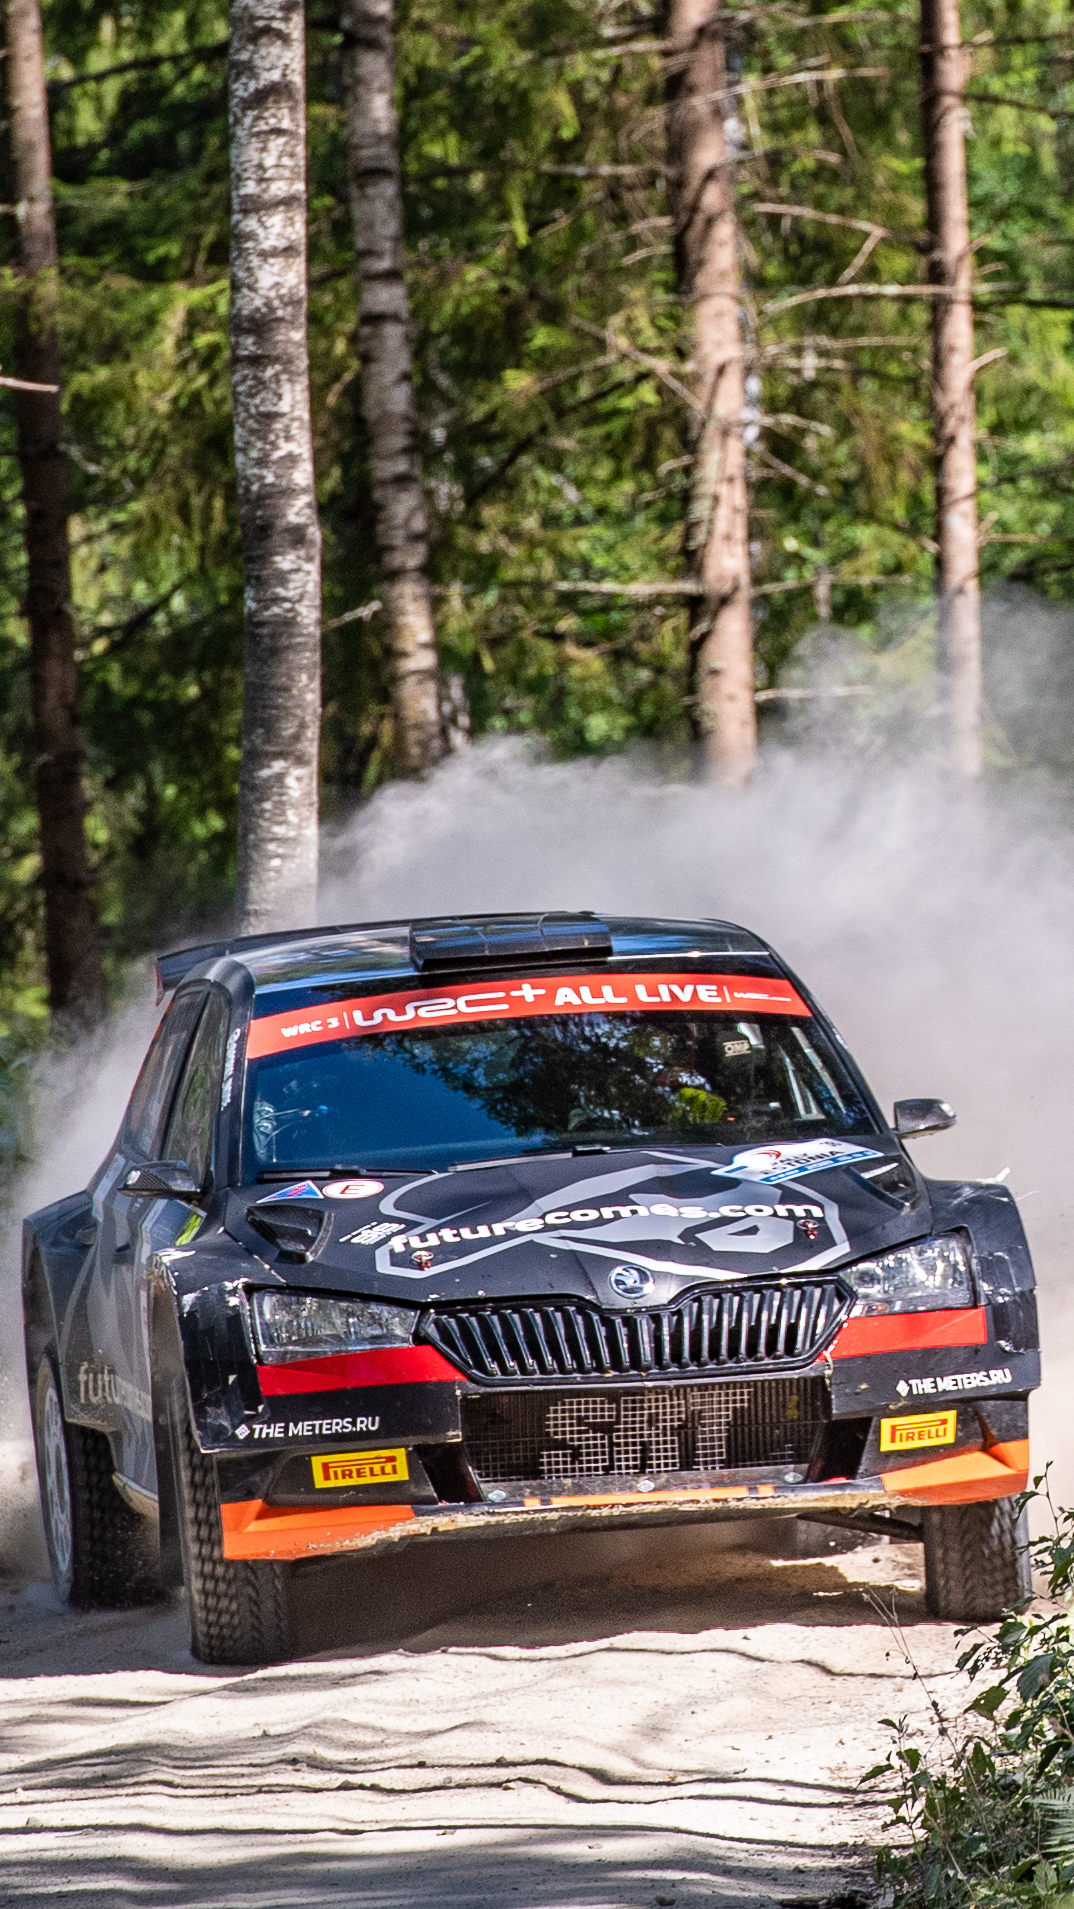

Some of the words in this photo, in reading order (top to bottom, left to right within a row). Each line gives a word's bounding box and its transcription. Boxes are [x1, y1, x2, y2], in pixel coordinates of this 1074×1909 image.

[281, 1019, 323, 1037] WRC
[327, 1017, 340, 1029] 3
[554, 985, 628, 1006] ALL
[634, 984, 722, 1003] LIVE
[339, 1184, 366, 1195] E
[387, 1202, 824, 1253] futurecomes.com
[908, 1378, 936, 1395] THE
[937, 1368, 1013, 1391] METERS.RU
[252, 1423, 285, 1439] THE
[288, 1416, 380, 1437] METERS.RU
[890, 1418, 948, 1444] PIRELLI
[321, 1455, 398, 1482] PIRELLI
